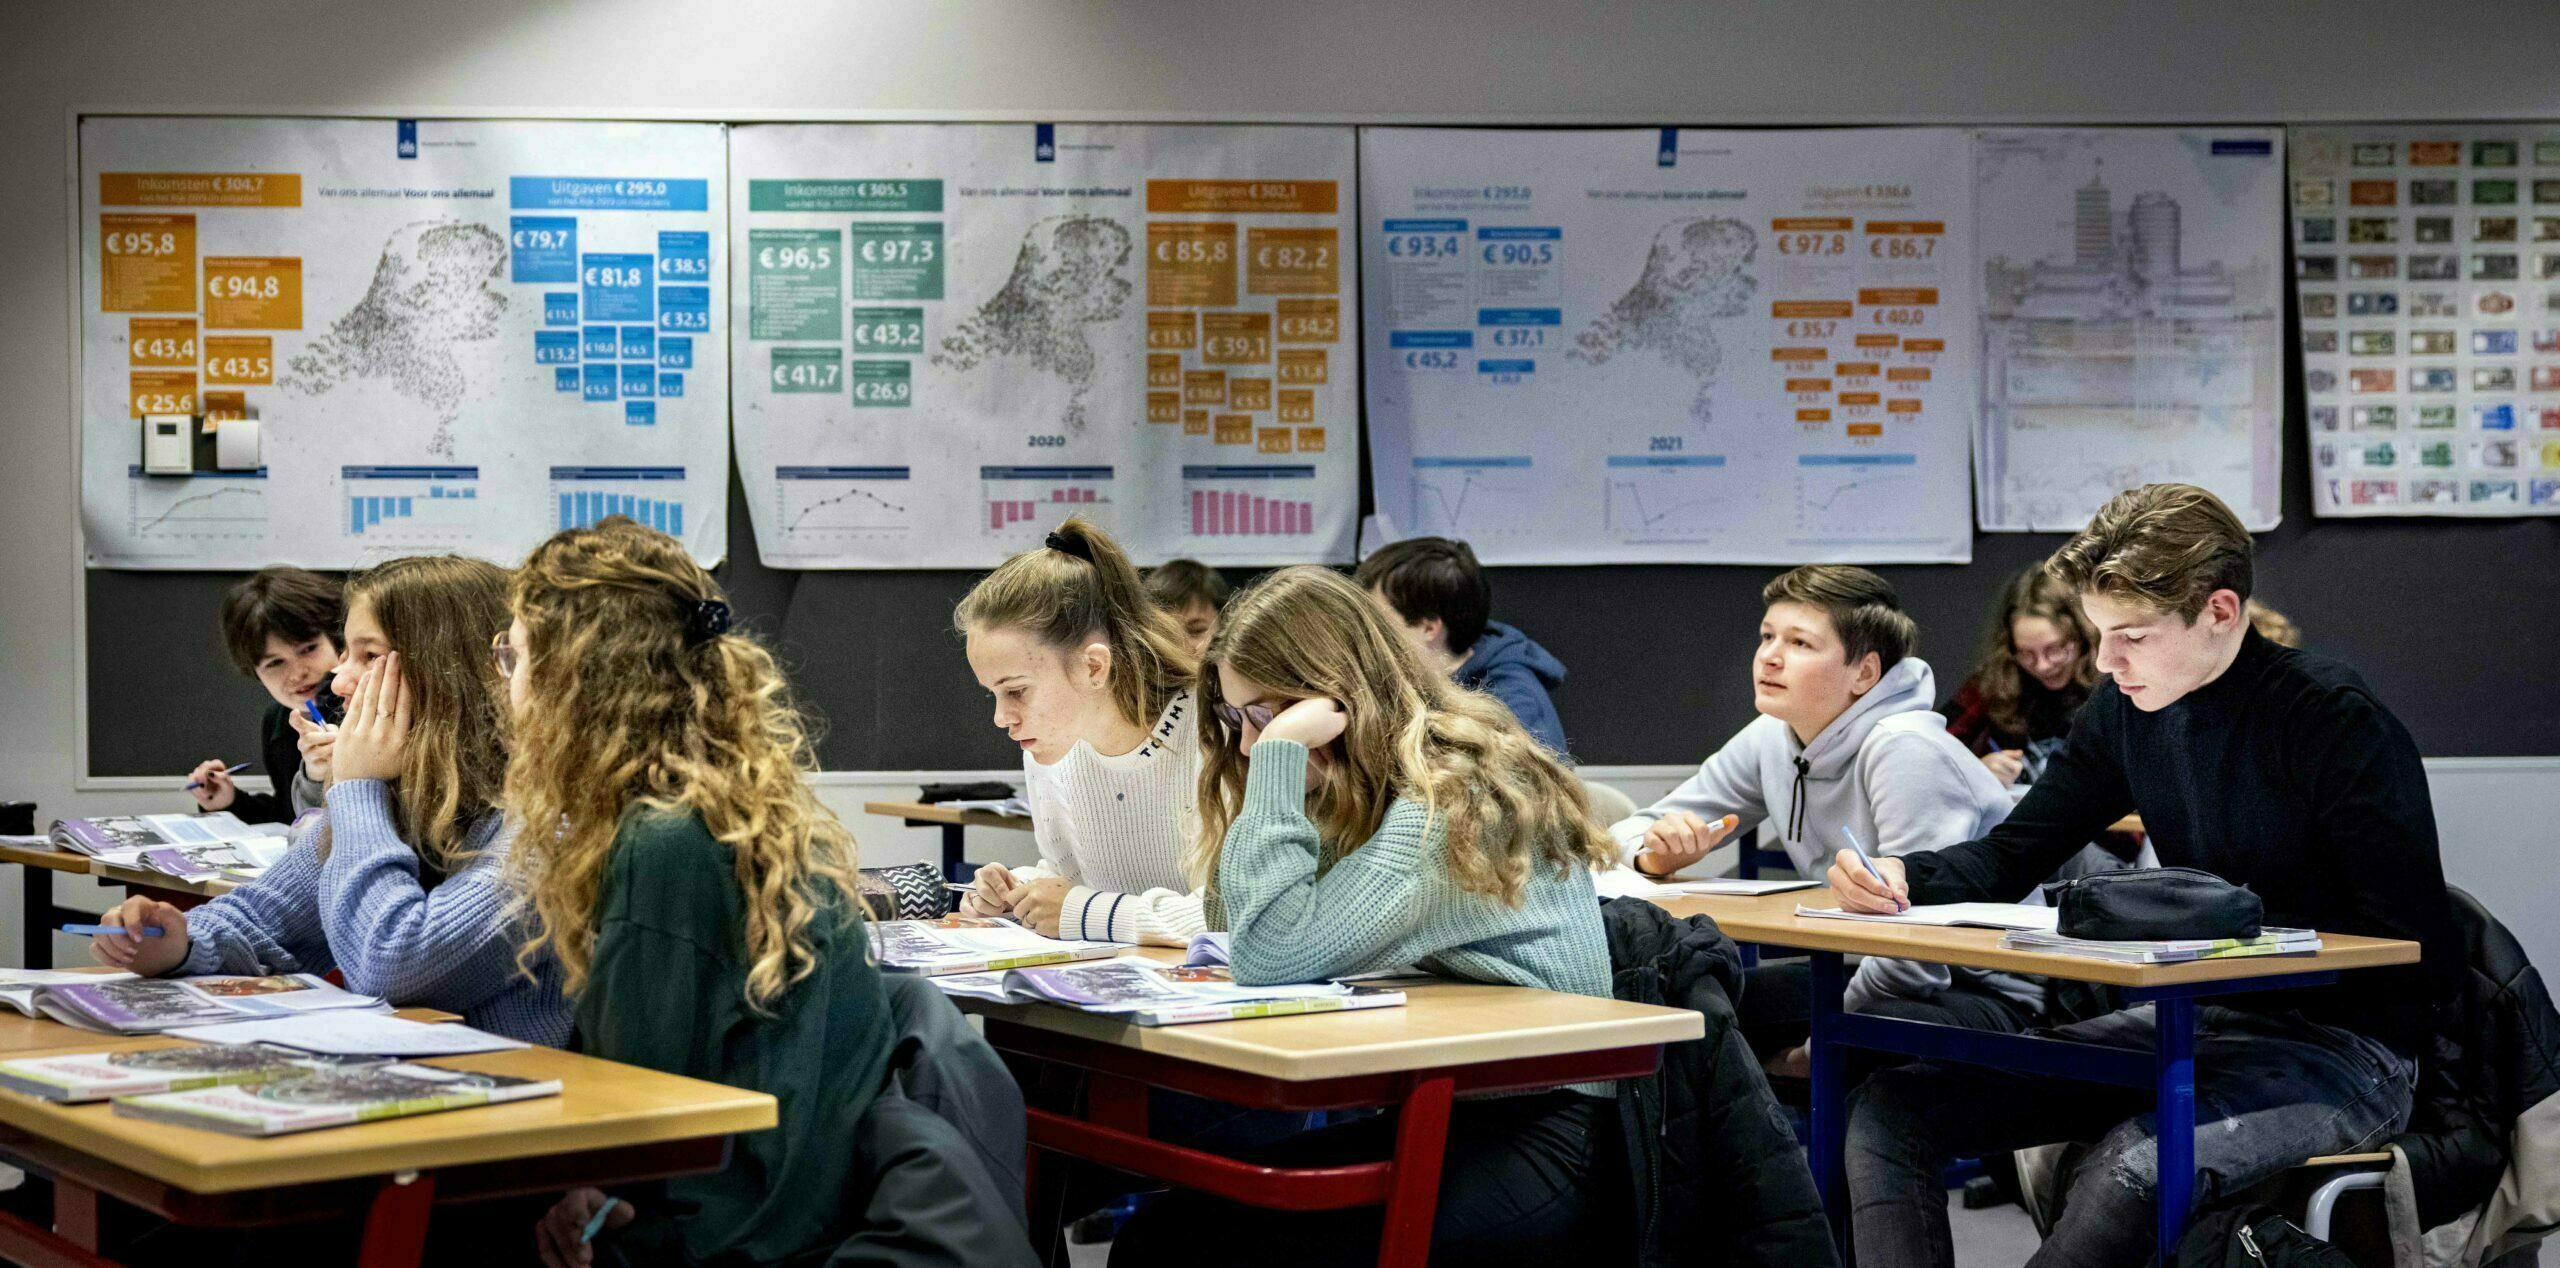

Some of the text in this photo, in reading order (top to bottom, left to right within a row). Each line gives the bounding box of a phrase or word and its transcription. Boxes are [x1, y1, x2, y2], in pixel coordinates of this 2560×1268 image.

[213, 177, 220, 192] €
[225, 177, 265, 192] 304,7
[403, 187, 428, 198] Voor
[431, 189, 450, 198] ons
[452, 187, 494, 198] allemaal
[552, 181, 667, 197] Uitgaven € 295,0
[784, 183, 908, 198] Inkomsten € 305,5
[106, 232, 175, 256] € 95,8
[513, 230, 568, 250] € 79,7
[1388, 236, 1458, 259] € 93,4
[1778, 234, 1845, 257] € 97,8
[1870, 238, 1936, 260] € 86,7
[759, 247, 831, 271] € 96,5
[861, 240, 934, 263] € 97,3
[1157, 241, 1228, 264] € 85,8
[1258, 247, 1329, 270] € 82,2
[1483, 243, 1553, 267] € 90,5
[660, 258, 706, 275] € 38,5
[208, 275, 224, 297] €
[227, 275, 279, 299] 94,8
[584, 267, 641, 288] € 81,8
[661, 311, 707, 328] € 32,5
[1281, 318, 1335, 336] € 34,2
[855, 324, 921, 347] € 43,2
[1150, 330, 1159, 343] €
[1493, 329, 1544, 347] € 37,1
[133, 338, 194, 360] € 43,4
[537, 348, 545, 360] €
[1206, 336, 1266, 359] € 39,1
[207, 357, 269, 379] € 43,5
[1406, 352, 1458, 369] € 45,2
[773, 365, 839, 387] € 41,7
[856, 383, 909, 400] € 26,9
[136, 394, 192, 413] € 25,6
[1028, 435, 1066, 448] 2020
[1650, 435, 1682, 451] 2021
[1140, 688, 1189, 757] TOMMY
